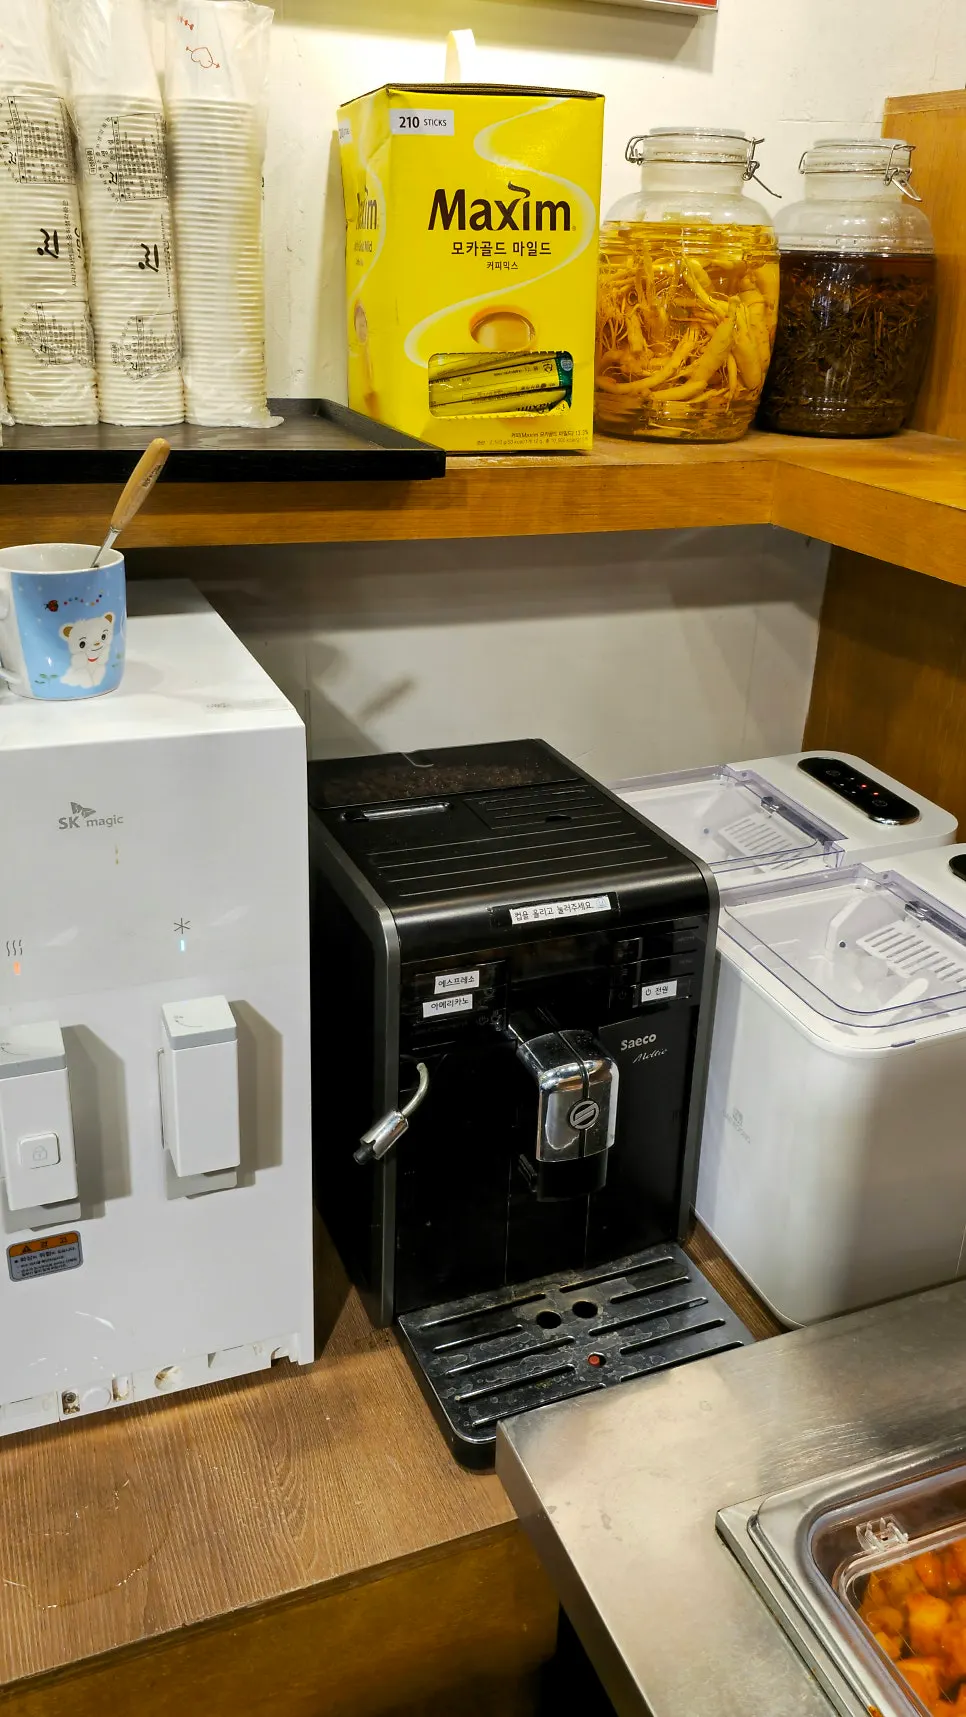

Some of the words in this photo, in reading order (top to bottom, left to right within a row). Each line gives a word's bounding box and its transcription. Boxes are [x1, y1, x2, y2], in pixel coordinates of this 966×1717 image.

[399, 116, 420, 129] 210
[423, 118, 447, 127] STICKS
[428, 181, 571, 232] Maxim
[451, 240, 507, 257] 모카골드
[512, 240, 552, 257] 마일드
[486, 260, 519, 271] 커피믹스
[58, 815, 80, 830] SK
[86, 814, 124, 829] magic
[515, 910, 529, 921] 컵을
[532, 906, 554, 919] 올리고
[438, 975, 475, 988] 에스프레소
[655, 985, 669, 996] 전원
[430, 997, 469, 1011] 아메리카노
[620, 1033, 657, 1051] Saeco
